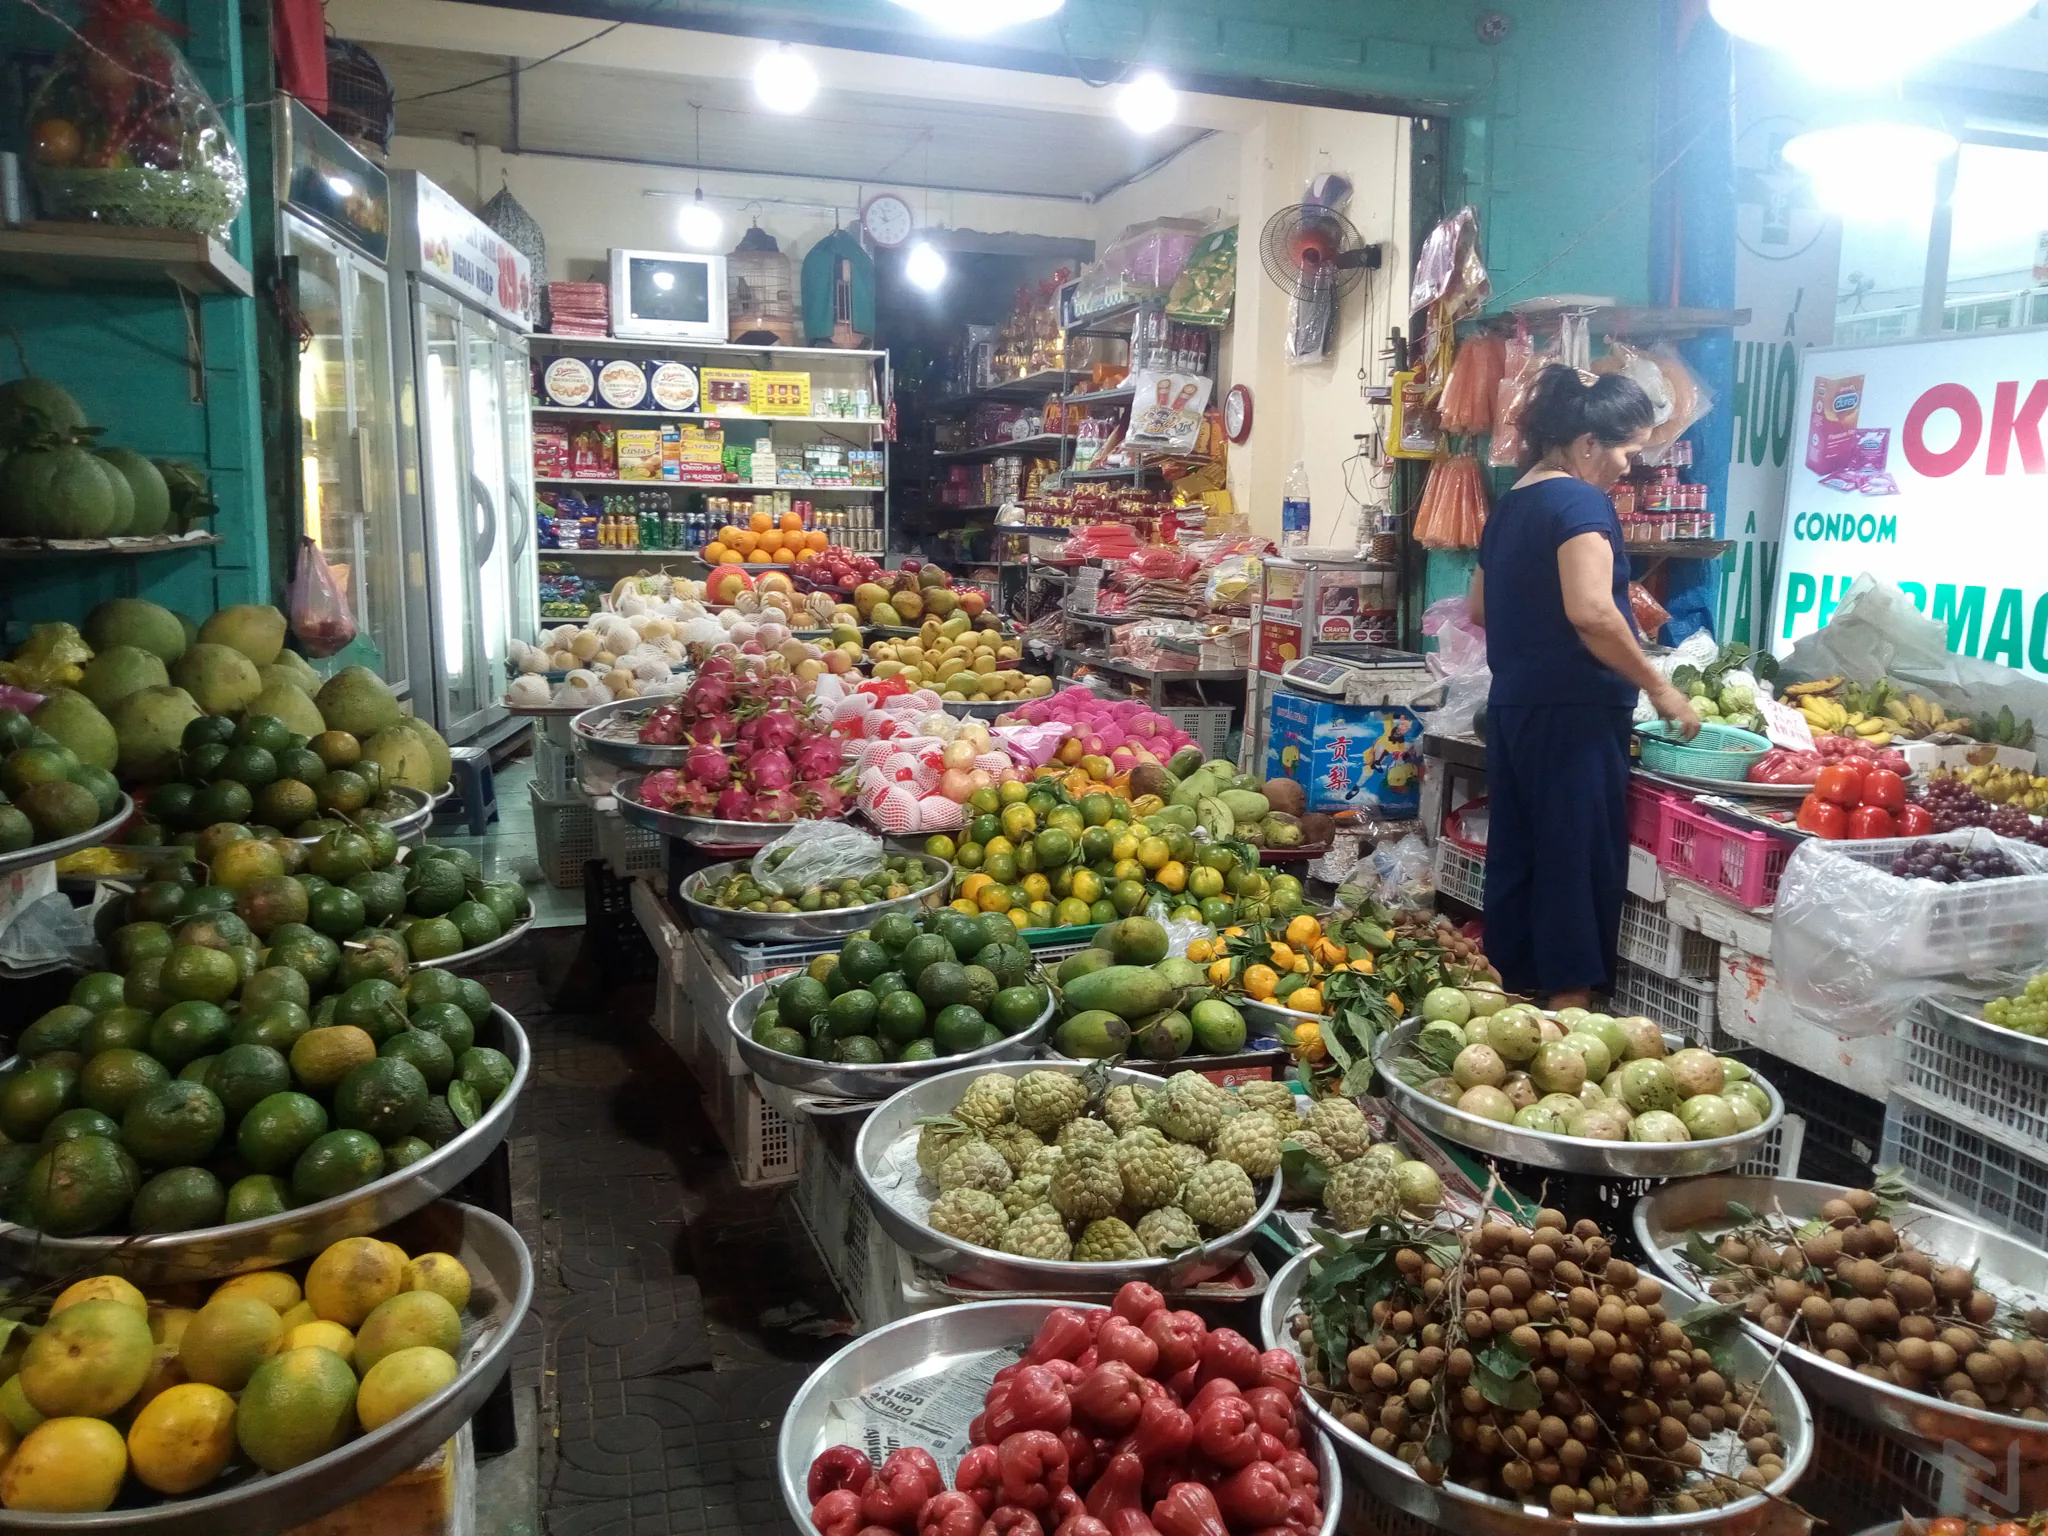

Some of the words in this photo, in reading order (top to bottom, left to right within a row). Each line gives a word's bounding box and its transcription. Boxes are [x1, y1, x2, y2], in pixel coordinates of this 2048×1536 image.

[1730, 287, 1803, 467] HUỐ
[1793, 512, 1897, 543] CONDOM
[1782, 572, 2048, 674] PHMAC
